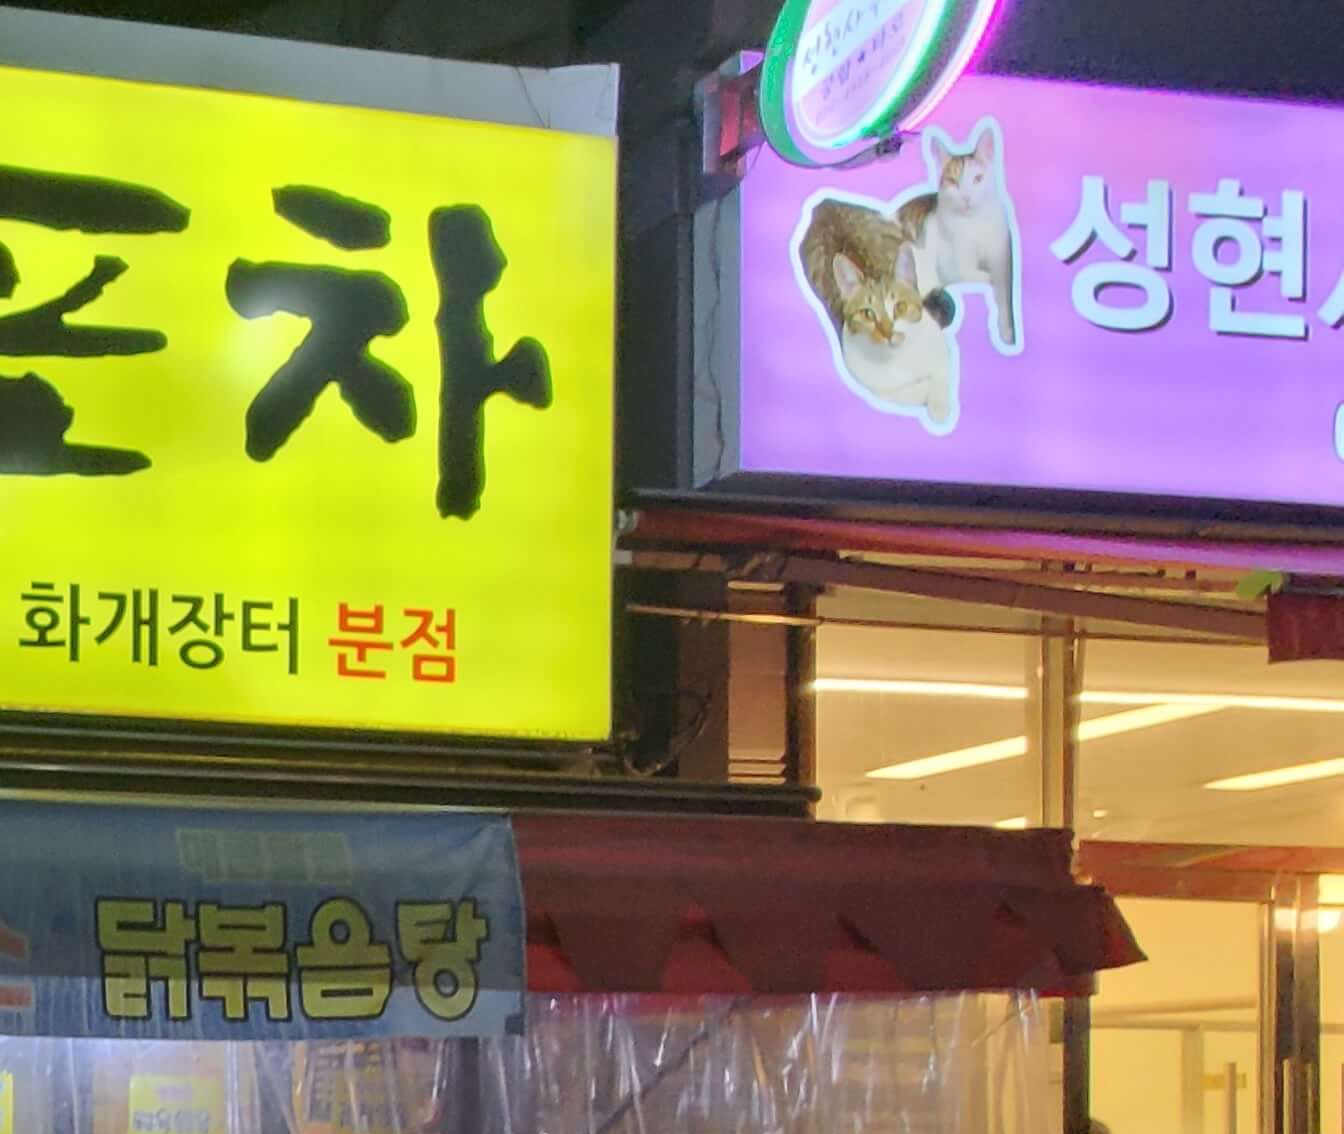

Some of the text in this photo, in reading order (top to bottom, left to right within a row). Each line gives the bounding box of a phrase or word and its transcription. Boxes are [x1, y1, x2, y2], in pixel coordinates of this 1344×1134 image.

[1049, 174, 1344, 342] 성현
[17, 580, 458, 685] 화개장터 분점
[94, 897, 490, 1021] 닭볶음탕
